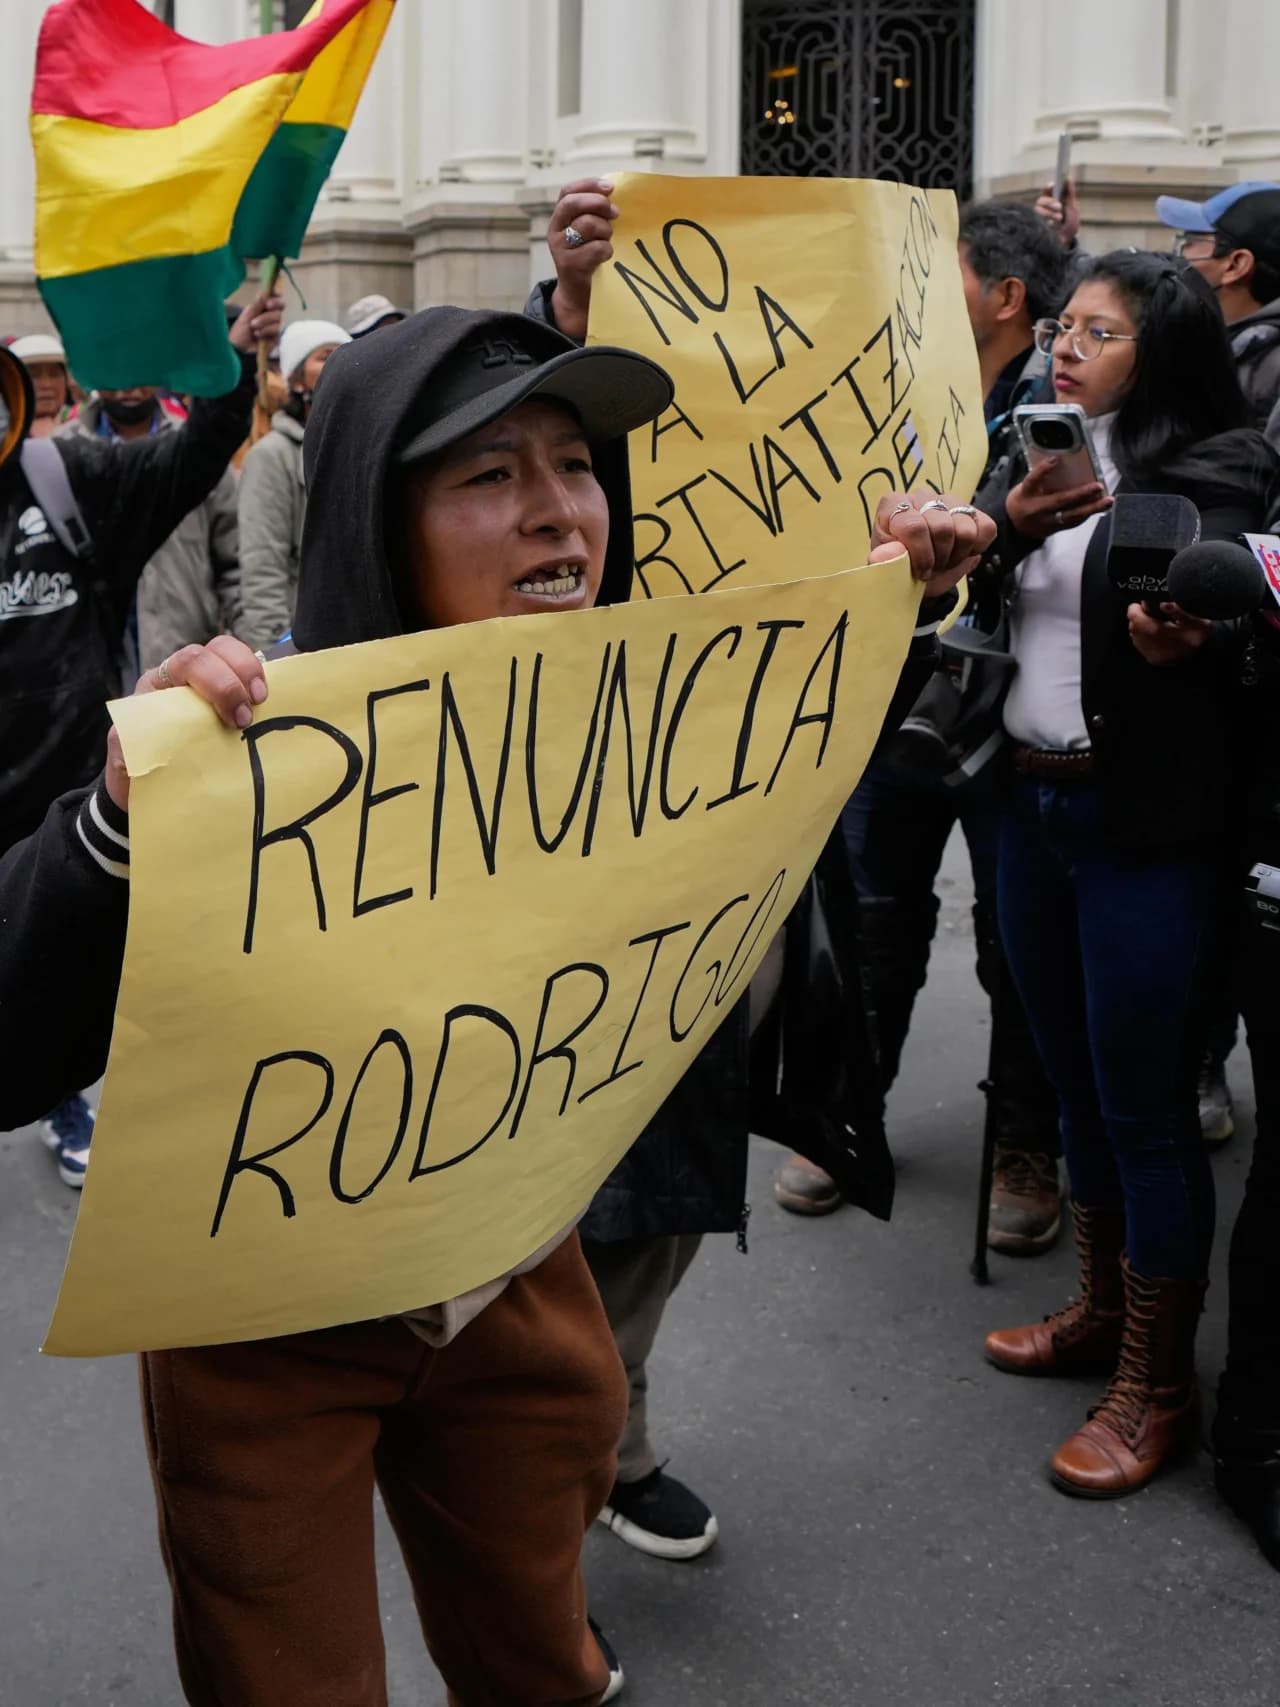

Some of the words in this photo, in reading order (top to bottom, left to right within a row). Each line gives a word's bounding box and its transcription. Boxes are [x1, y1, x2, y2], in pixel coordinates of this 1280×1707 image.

[613, 217, 729, 346] NO
[633, 189, 939, 599] RIVATIZACION
[651, 400, 704, 463] A
[712, 286, 814, 405] LA
[926, 386, 965, 494] VIA
[241, 609, 851, 954] RENUNCIA
[211, 867, 786, 1238] RODRIGO
